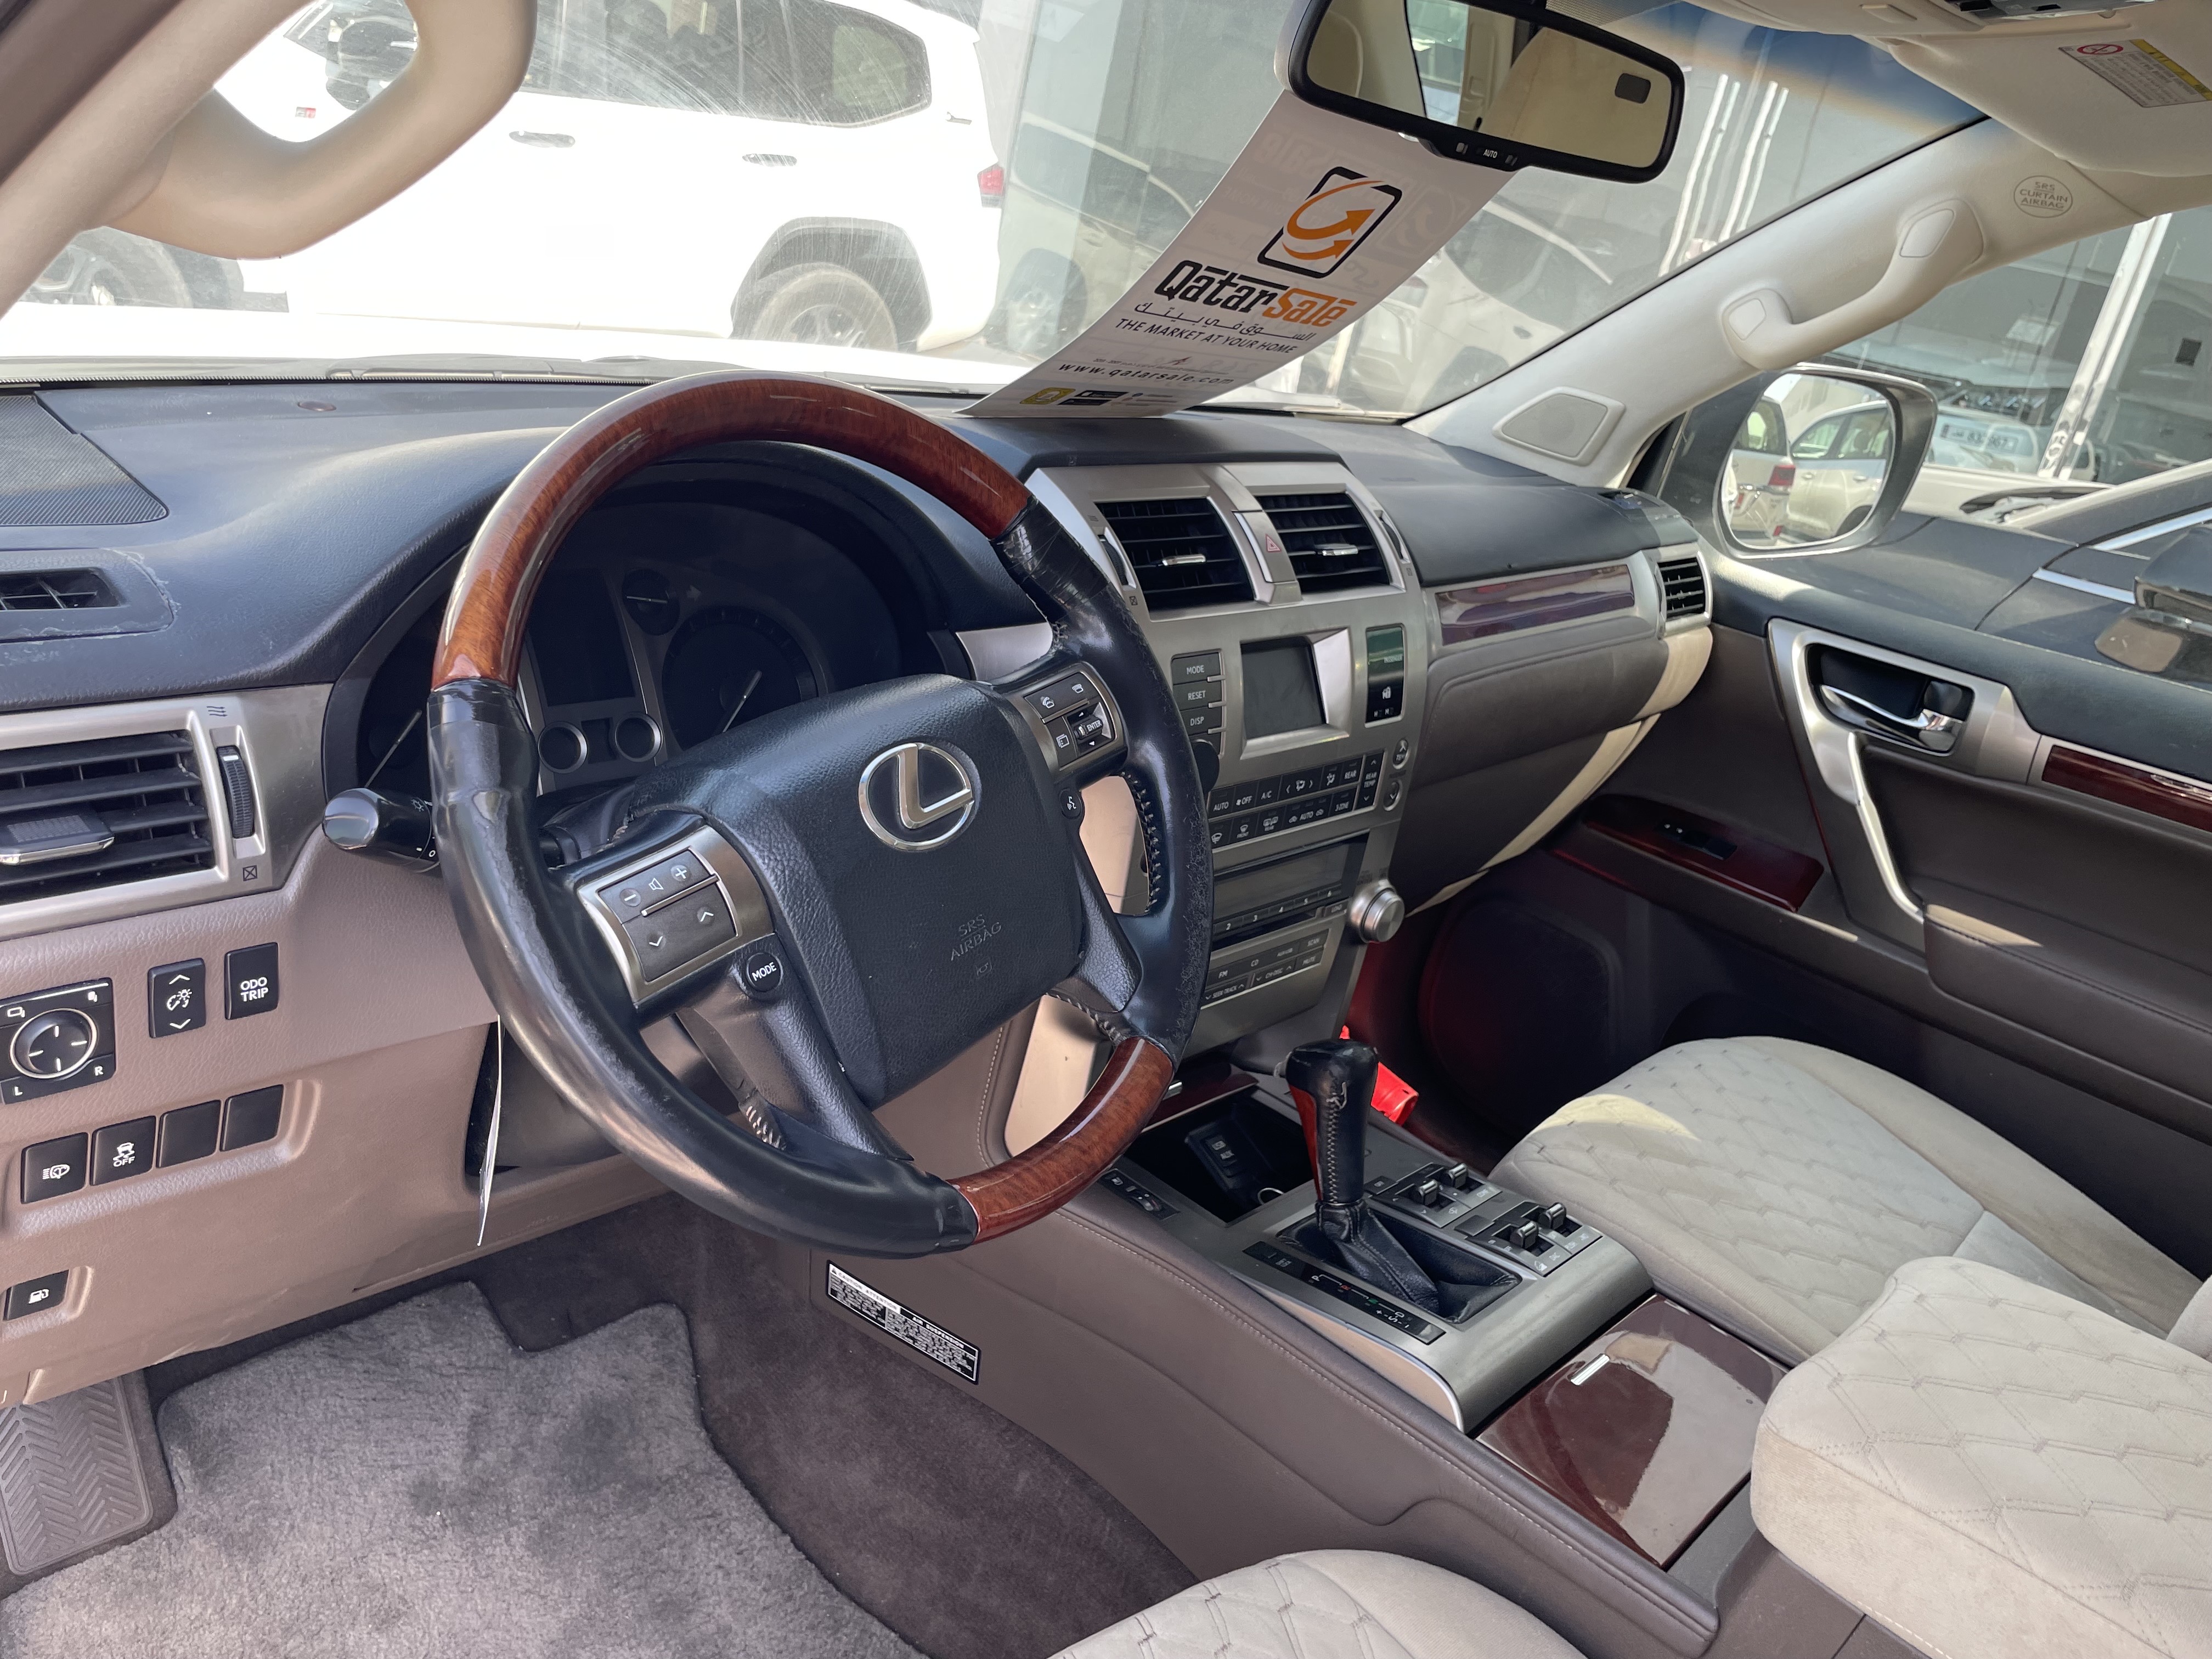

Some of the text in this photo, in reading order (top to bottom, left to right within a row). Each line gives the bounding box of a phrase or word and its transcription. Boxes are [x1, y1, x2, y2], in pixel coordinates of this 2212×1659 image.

[1483, 149, 1498, 159] AUTO
[2035, 182, 2055, 191] SRS
[2019, 189, 2068, 202] CURTAIN
[2021, 198, 2064, 208] AIRBAG
[1115, 318, 1297, 354] THE MARKET AT YOUR HOME
[1058, 362, 1236, 385] www.qatarsale.com
[1186, 664, 1205, 675] MODE
[1188, 690, 1206, 701] RESET
[1086, 720, 1102, 732] ENTER
[1190, 716, 1204, 726] DISP
[1344, 770, 1357, 780] REAR
[1365, 771, 1377, 780] REAR
[1241, 795, 1253, 805] OFF
[1261, 790, 1272, 800] A/C
[1213, 801, 1229, 811] AUTO
[1299, 811, 1314, 821] AUTO
[958, 914, 985, 936] SRS
[950, 922, 1001, 961] AIRBAG
[1250, 959, 1259, 967] CD
[752, 962, 777, 981] MODE
[240, 977, 268, 991] ODO
[240, 988, 269, 1002] TRIP
[94, 1065, 104, 1076] R
[14, 1086, 23, 1097] L
[113, 1155, 134, 1167] OFF
